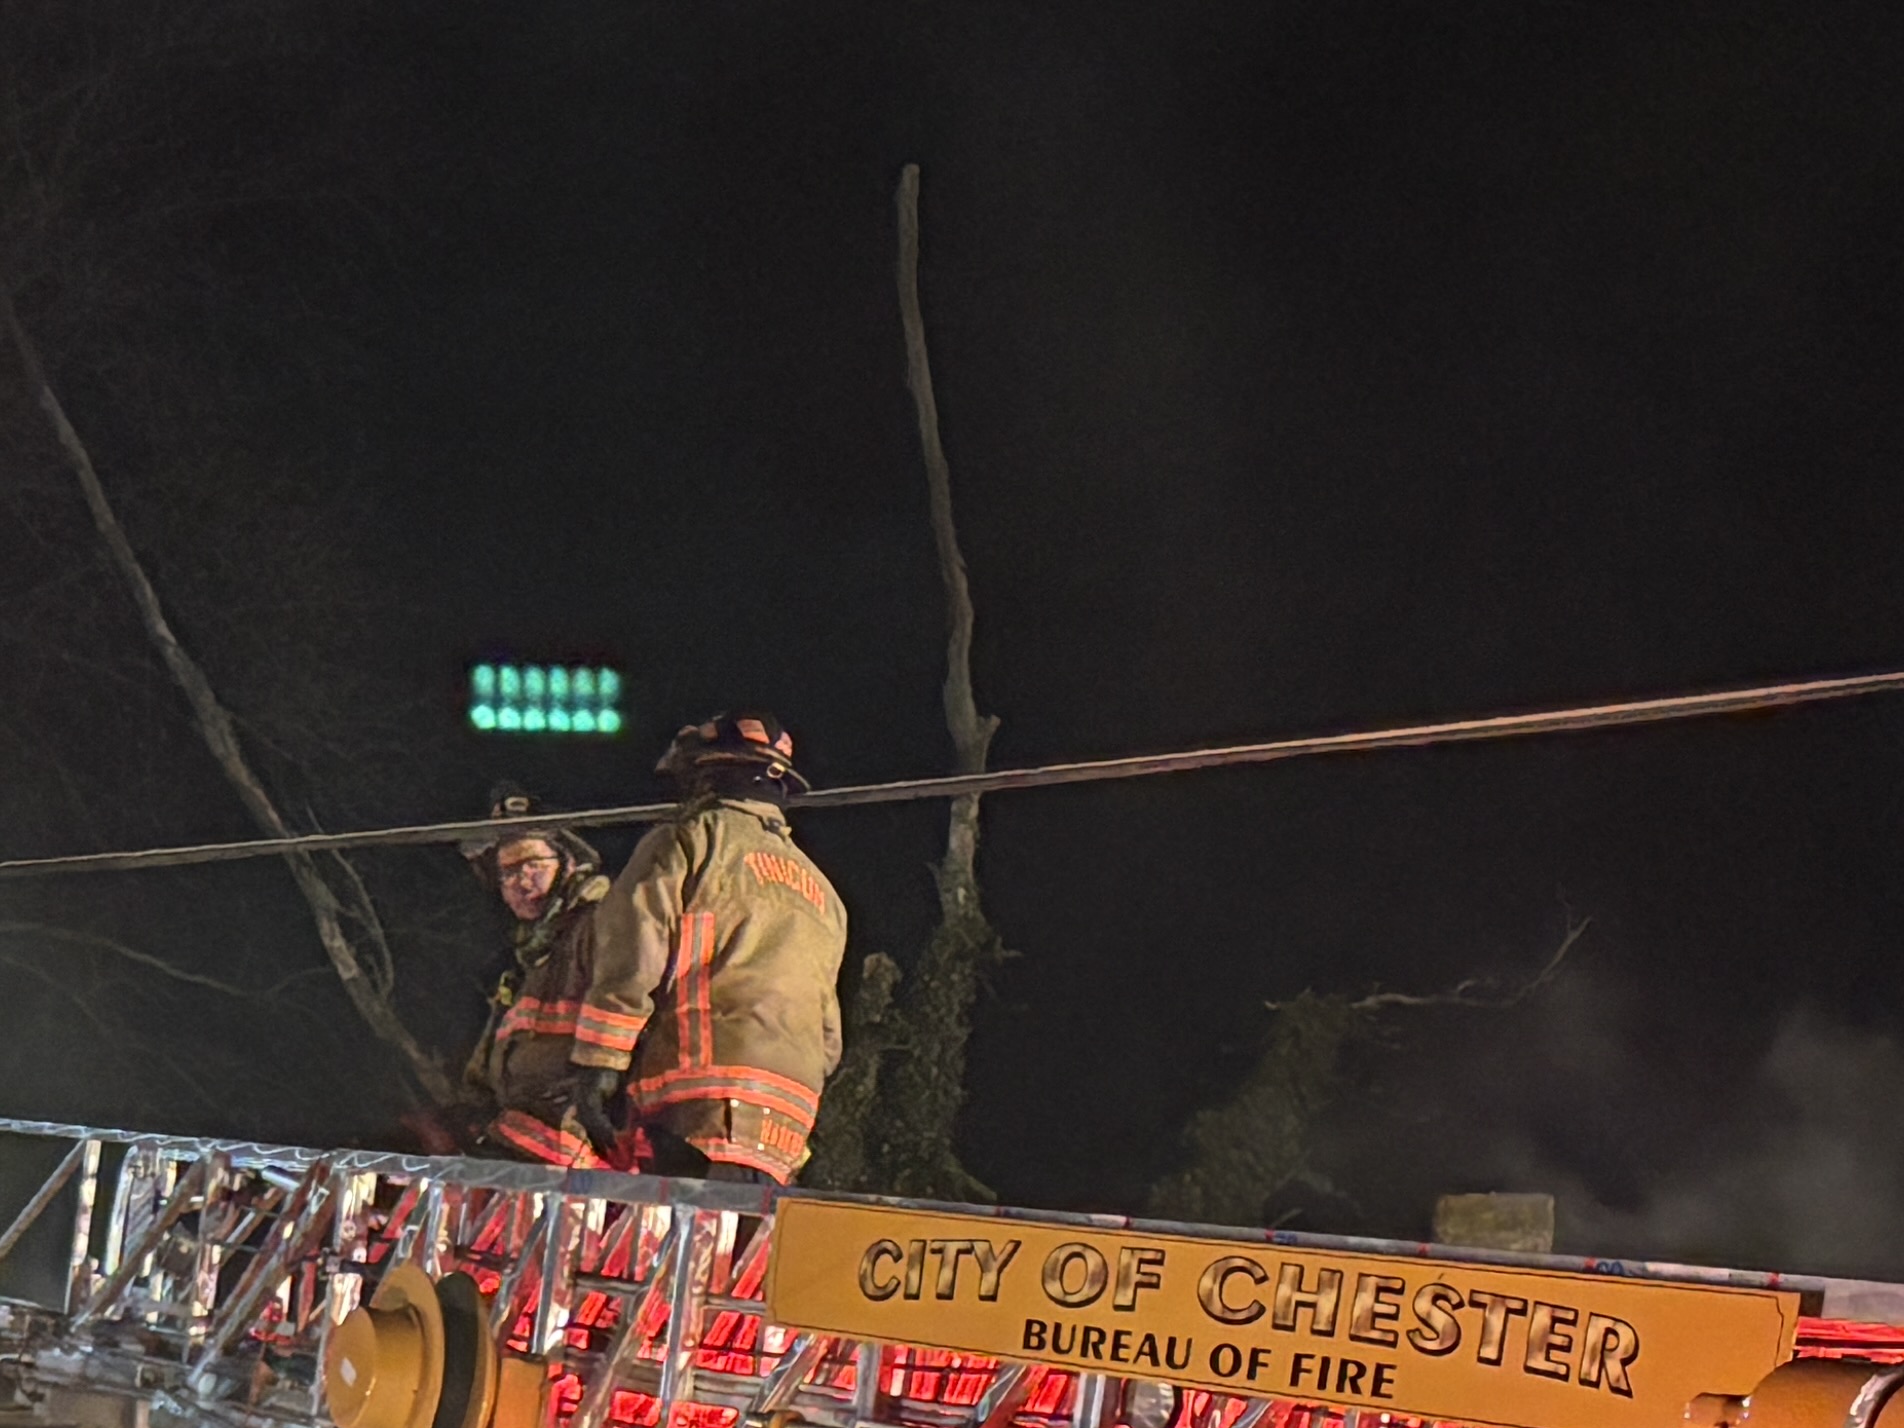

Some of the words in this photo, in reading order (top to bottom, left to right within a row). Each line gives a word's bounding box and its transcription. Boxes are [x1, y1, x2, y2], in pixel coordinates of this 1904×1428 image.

[858, 1238, 1022, 1302] CITY
[1041, 1242, 1166, 1312] OF
[1196, 1255, 1640, 1398] CHESTER
[1022, 1319, 1193, 1370] BUREAU
[1208, 1342, 1272, 1381] OF
[1289, 1353, 1398, 1399] FIRE
